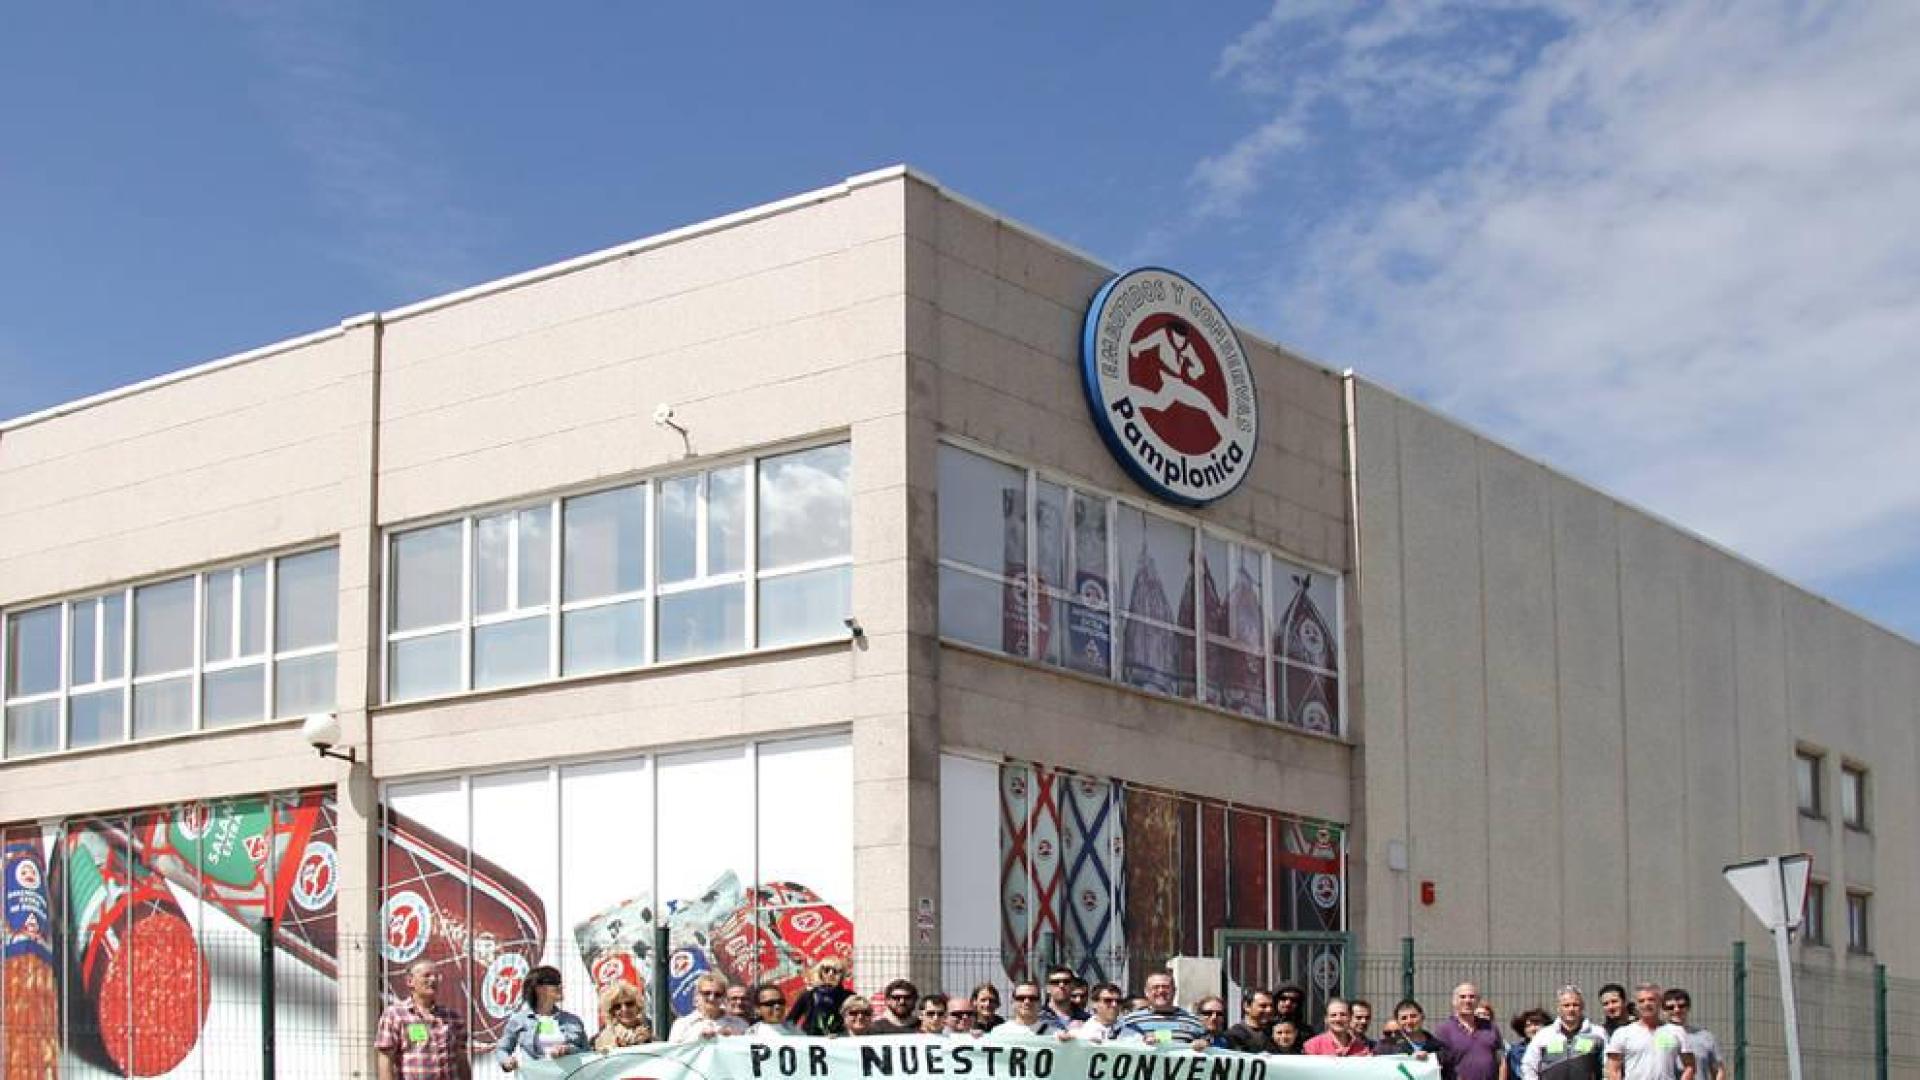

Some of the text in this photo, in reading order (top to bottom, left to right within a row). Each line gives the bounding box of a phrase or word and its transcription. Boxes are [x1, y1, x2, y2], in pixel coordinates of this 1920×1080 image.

[1171, 281, 1184, 305] Y
[1111, 396, 1244, 487] Pamplonica
[750, 1044, 1268, 1080] POR NUESTRO CONVENIO
